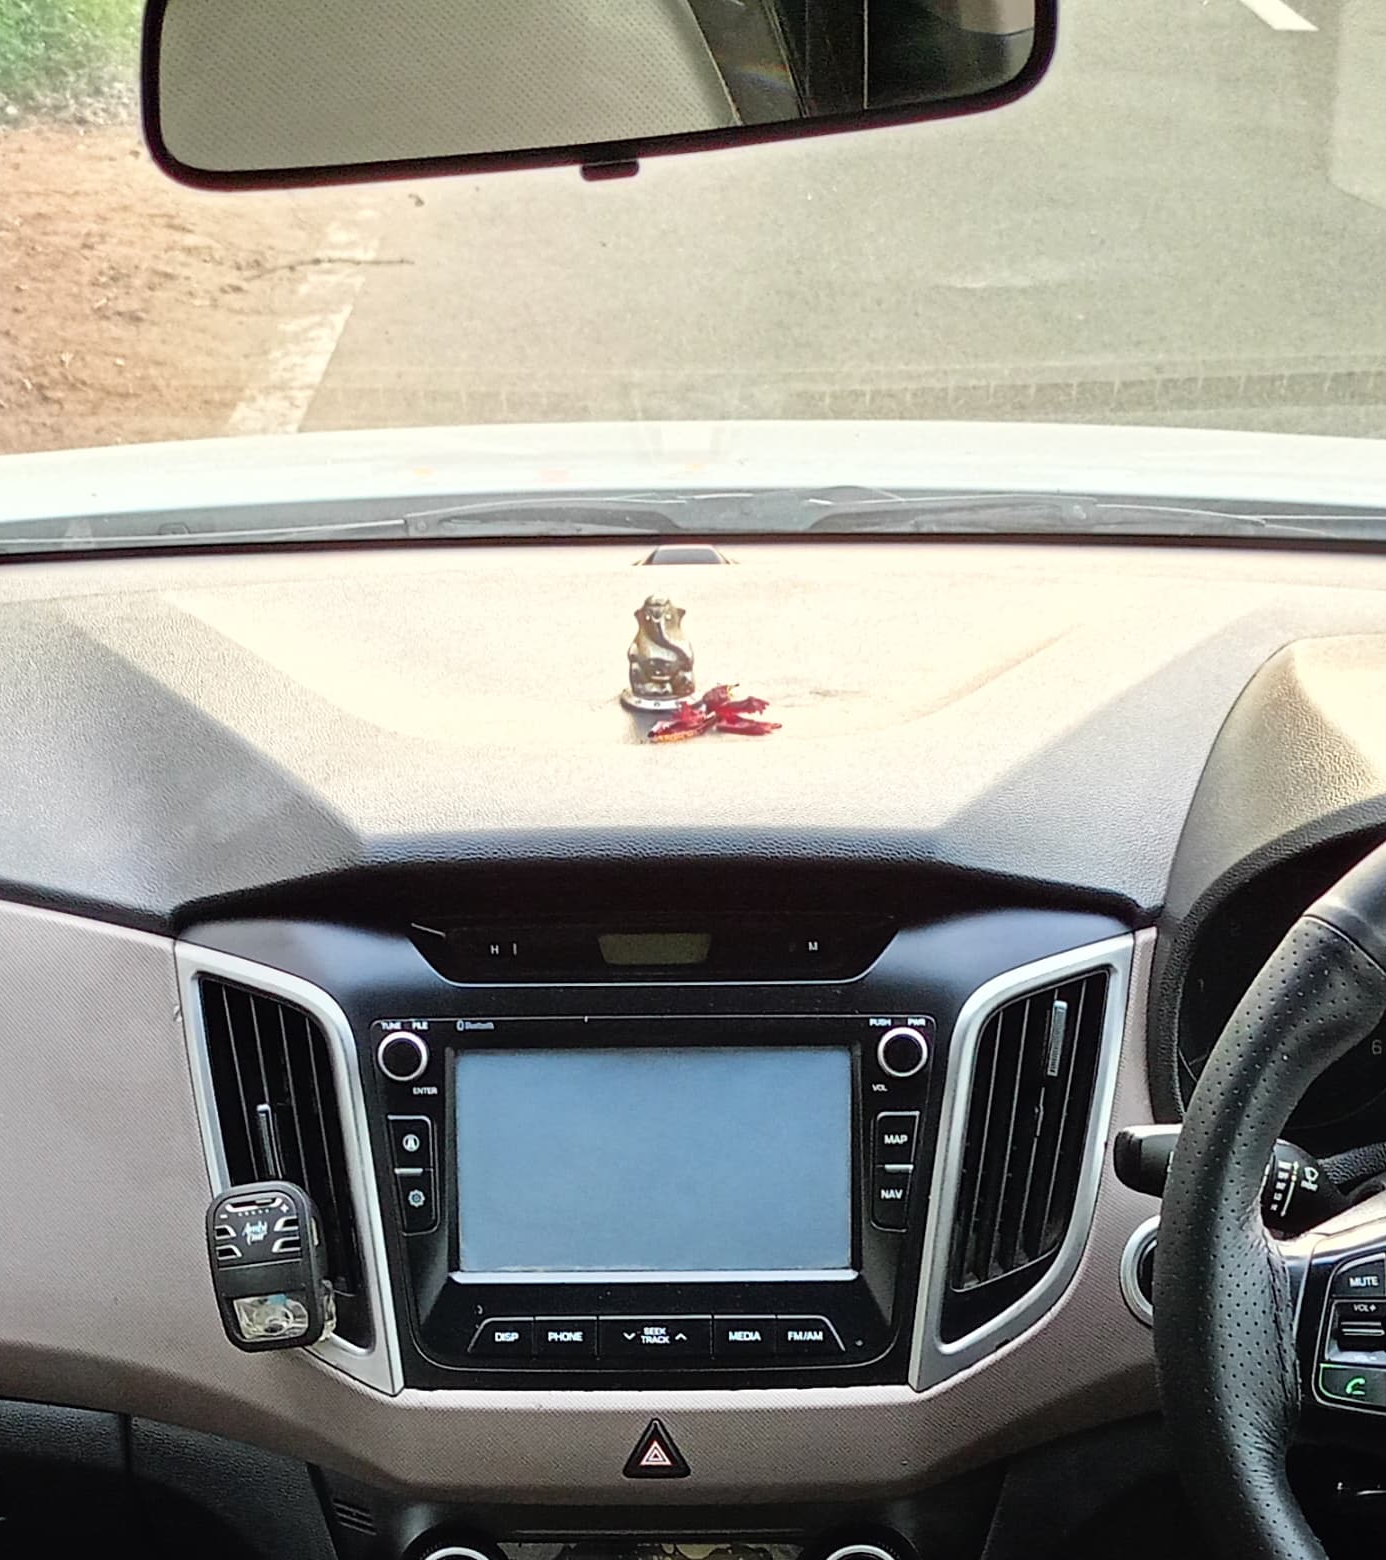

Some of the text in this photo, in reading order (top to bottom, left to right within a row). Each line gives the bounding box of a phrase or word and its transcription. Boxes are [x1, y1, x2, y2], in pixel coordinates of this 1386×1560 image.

[869, 1017, 926, 1027] PUSH PWR
[1371, 1039, 1382, 1055] 6
[412, 1086, 438, 1095] ENTER
[871, 1083, 888, 1092] VOL
[884, 1134, 909, 1145] MAP
[880, 1188, 904, 1199] NAV
[1349, 1275, 1379, 1287] MUTE
[494, 1332, 520, 1342] DISP
[547, 1331, 584, 1342] PHONE
[641, 1334, 670, 1345] TRACK
[728, 1331, 762, 1342] MEDIA
[787, 1331, 824, 1342] FM/AM
